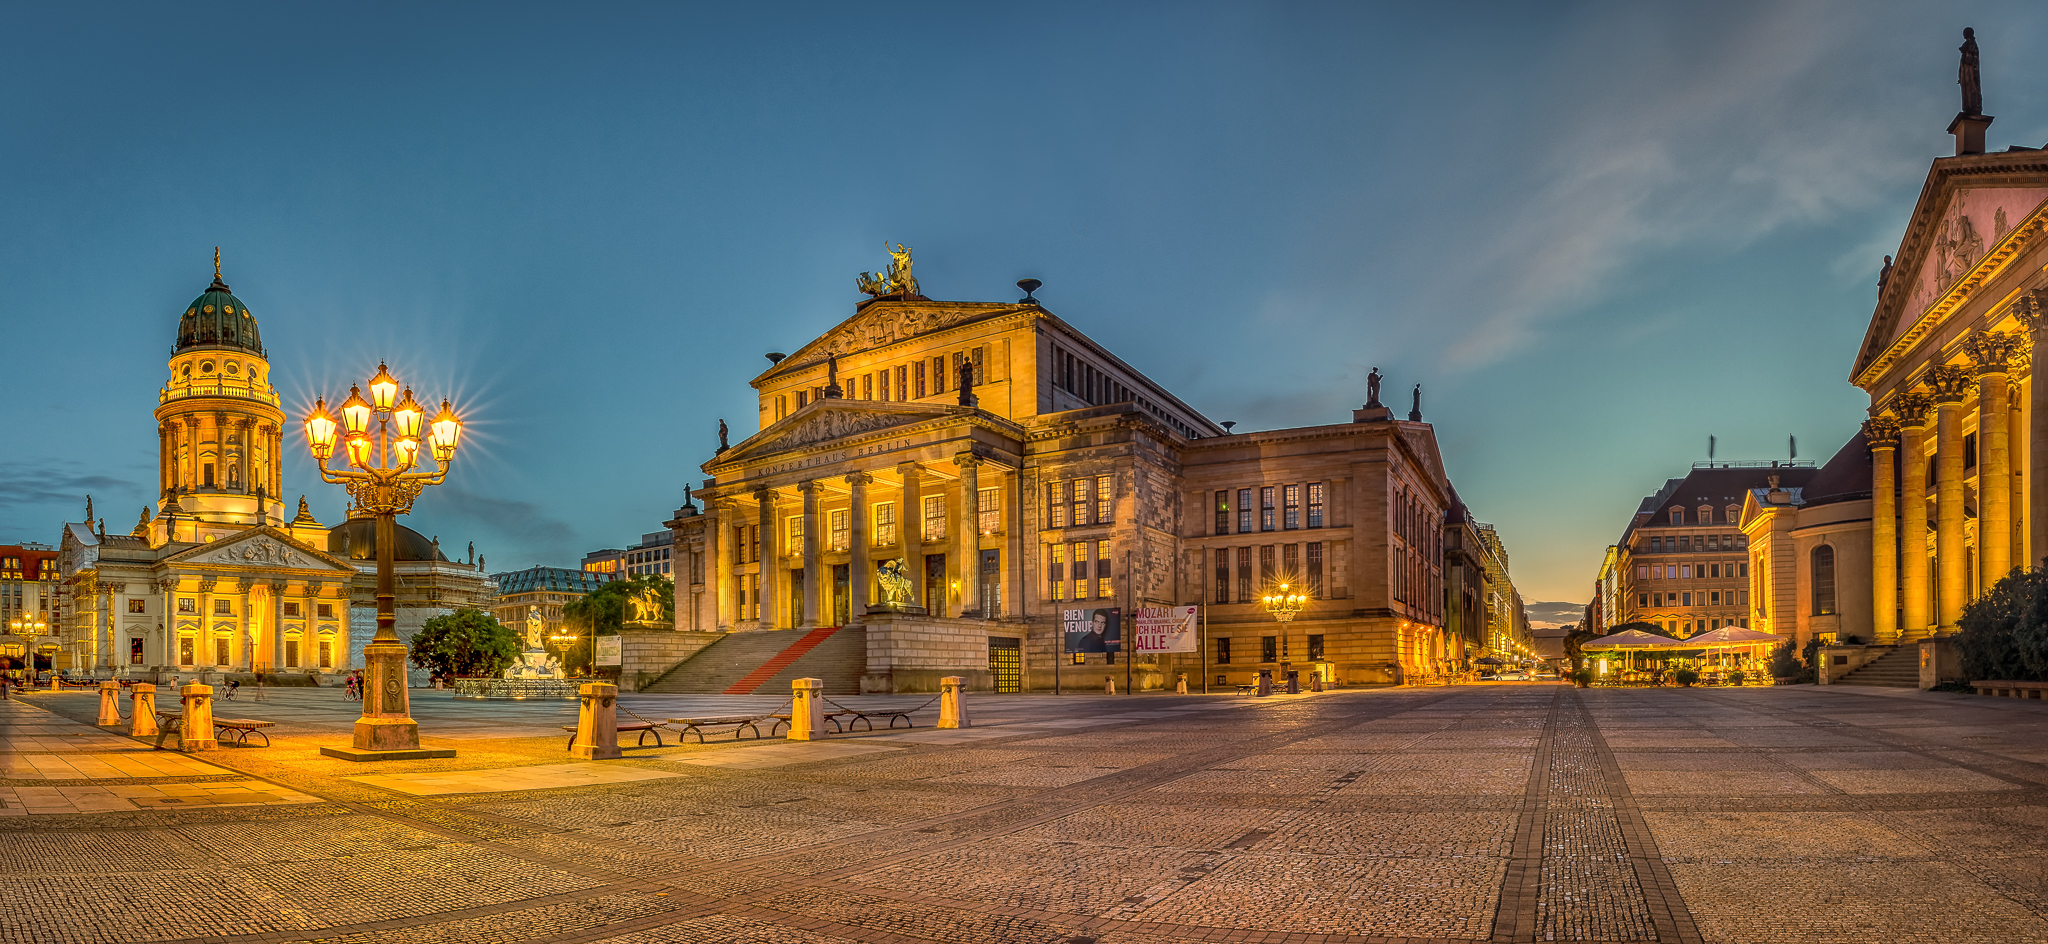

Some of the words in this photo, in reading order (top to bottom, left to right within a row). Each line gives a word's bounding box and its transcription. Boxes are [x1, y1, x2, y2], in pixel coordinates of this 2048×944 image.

[758, 451, 847, 477] KONZERTHAUS
[858, 438, 910, 457] BERLIN
[1064, 609, 1084, 621] BIEN
[1136, 607, 1177, 618] MOZART,
[1064, 621, 1093, 633] VENUE
[1136, 625, 1149, 635] ICH
[1151, 624, 1175, 634] HATTE
[1176, 624, 1189, 633] SIE
[1136, 634, 1170, 650] ALLE.
